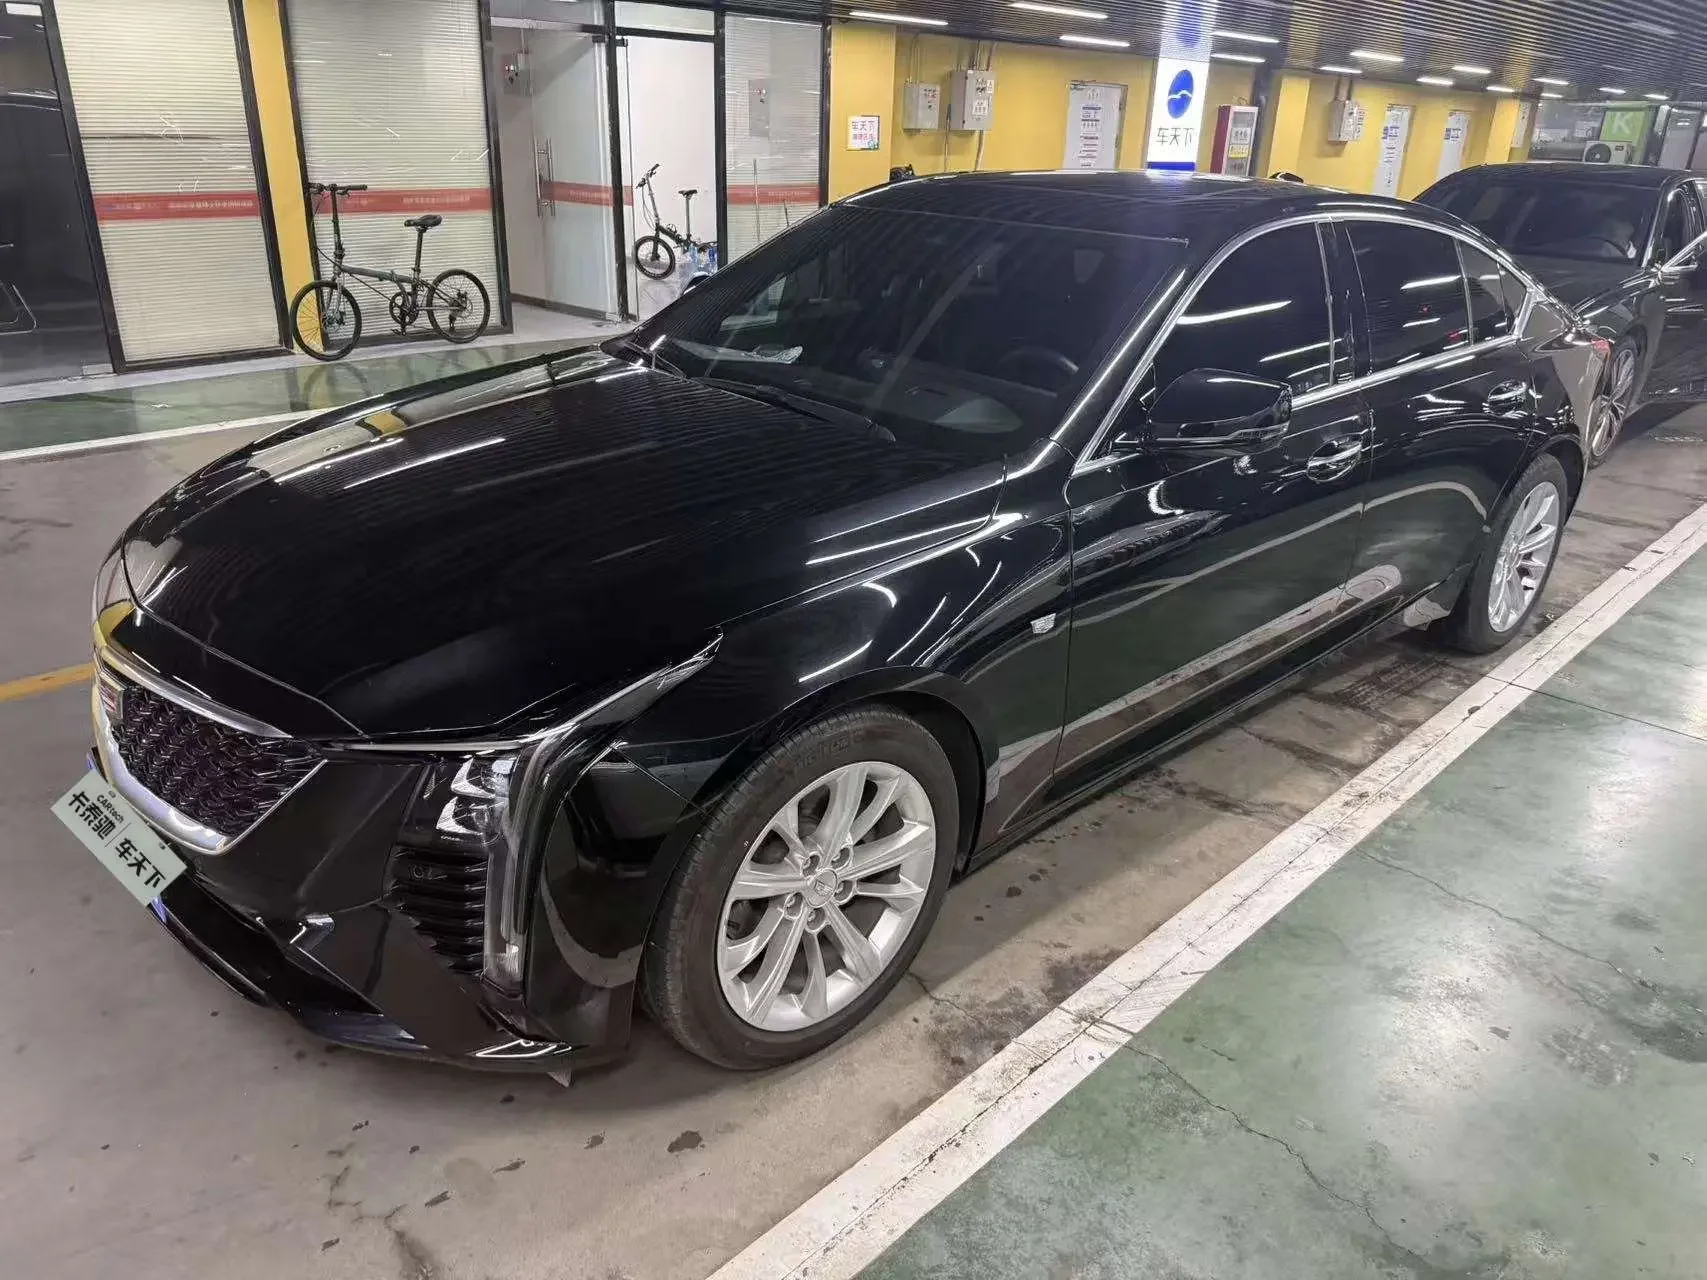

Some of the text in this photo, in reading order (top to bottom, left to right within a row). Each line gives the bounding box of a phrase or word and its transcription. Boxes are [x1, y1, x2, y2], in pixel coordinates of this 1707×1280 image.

[1156, 127, 1195, 147] 车天下
[1612, 111, 1634, 135] K
[68, 791, 117, 840] 卡泰驰
[115, 837, 166, 889] 车天下
